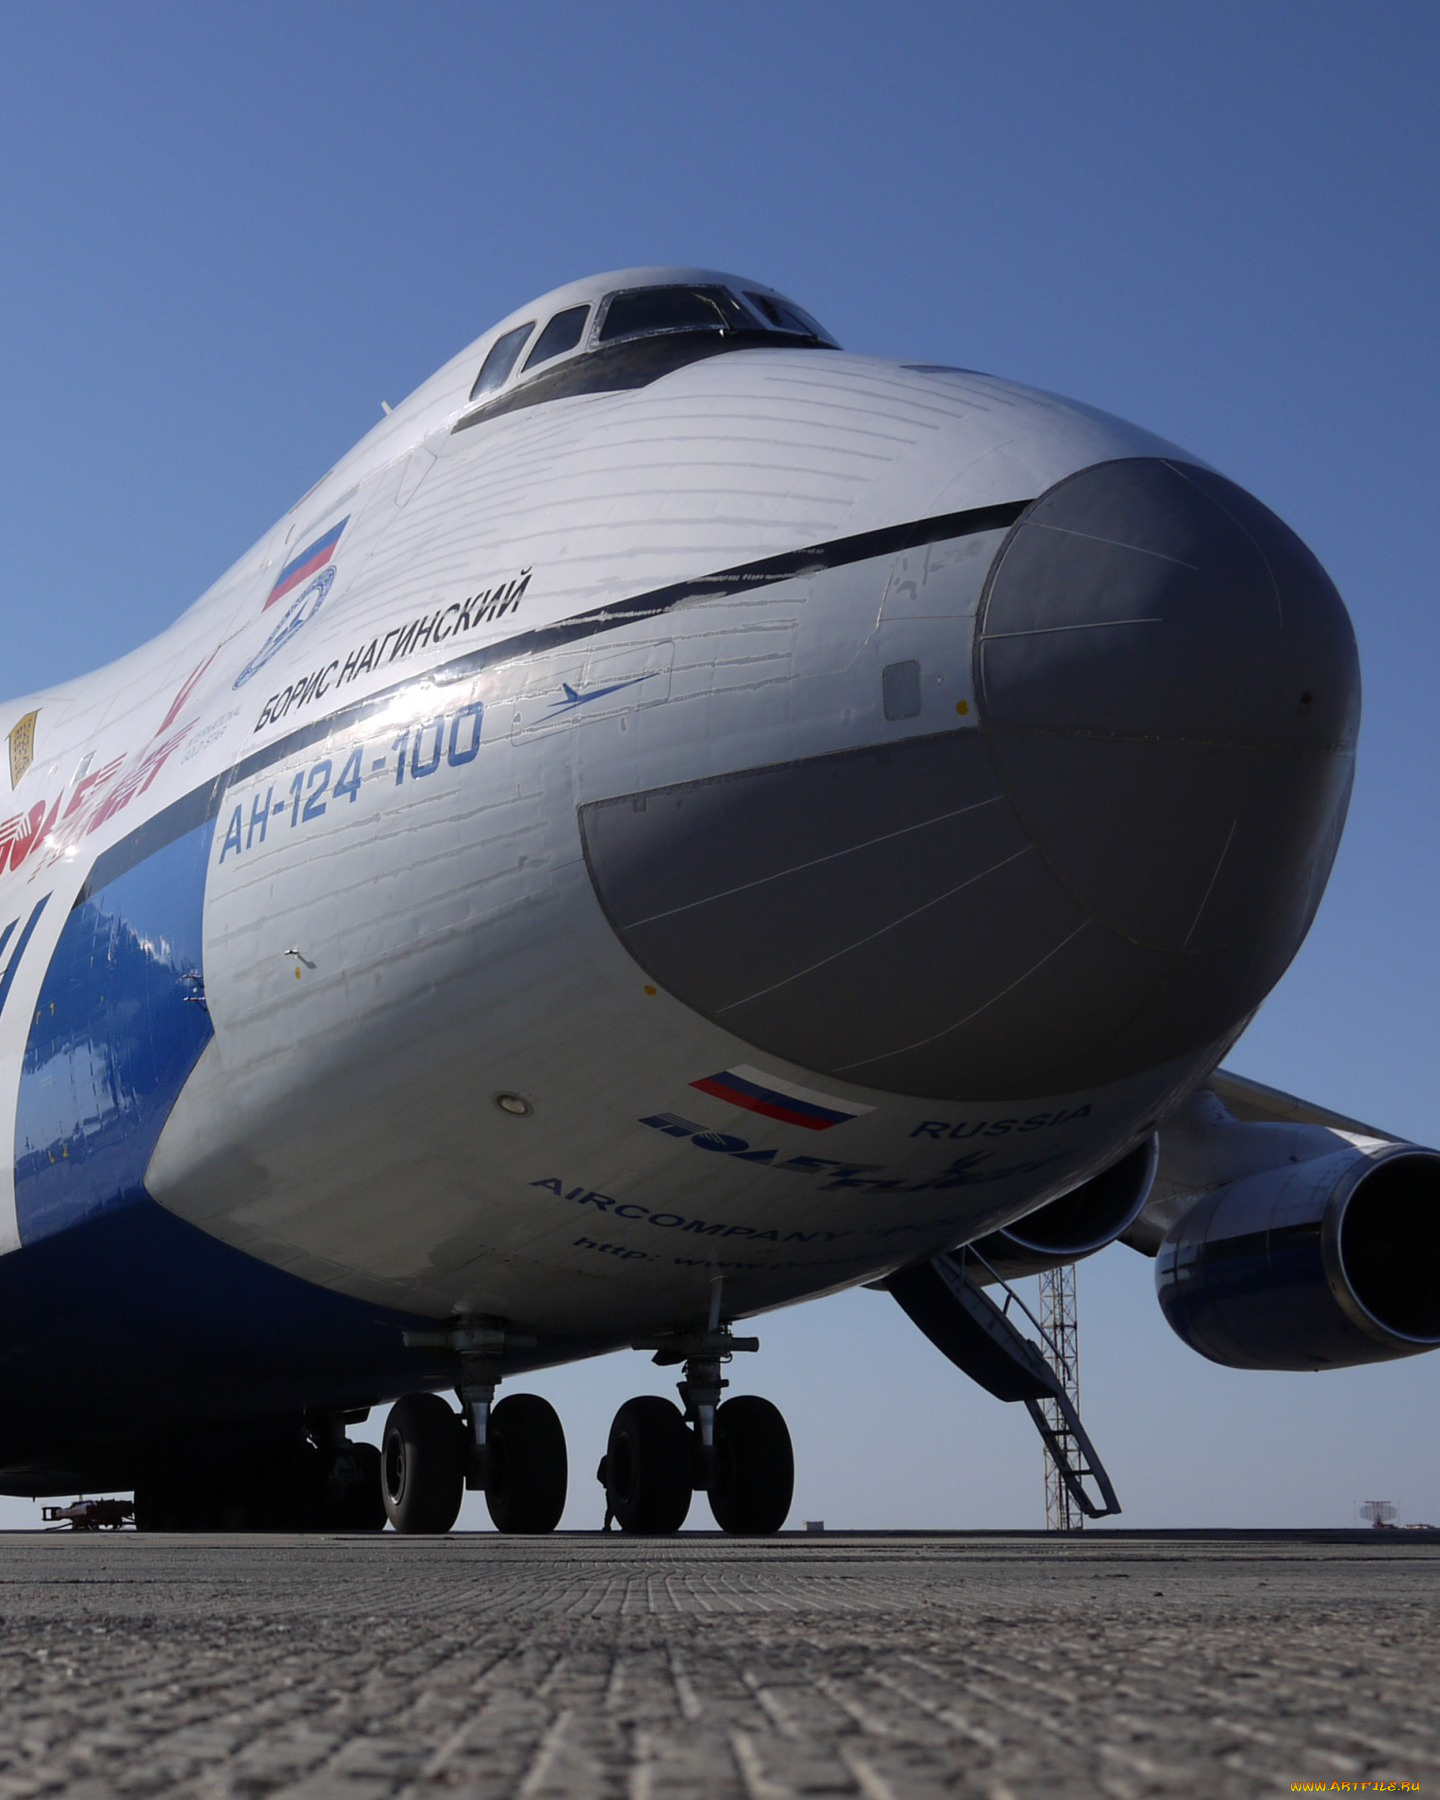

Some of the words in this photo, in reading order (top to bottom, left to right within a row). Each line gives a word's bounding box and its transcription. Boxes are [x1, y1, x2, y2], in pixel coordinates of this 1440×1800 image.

[254, 660, 339, 734] БОРИС
[335, 567, 534, 690] НАГИНСКИЙ
[218, 701, 484, 864] АН-124-100
[909, 1103, 1094, 1140] RUSSIA
[529, 1177, 852, 1243] AIRCOMPANY
[572, 1236, 662, 1262] http:
